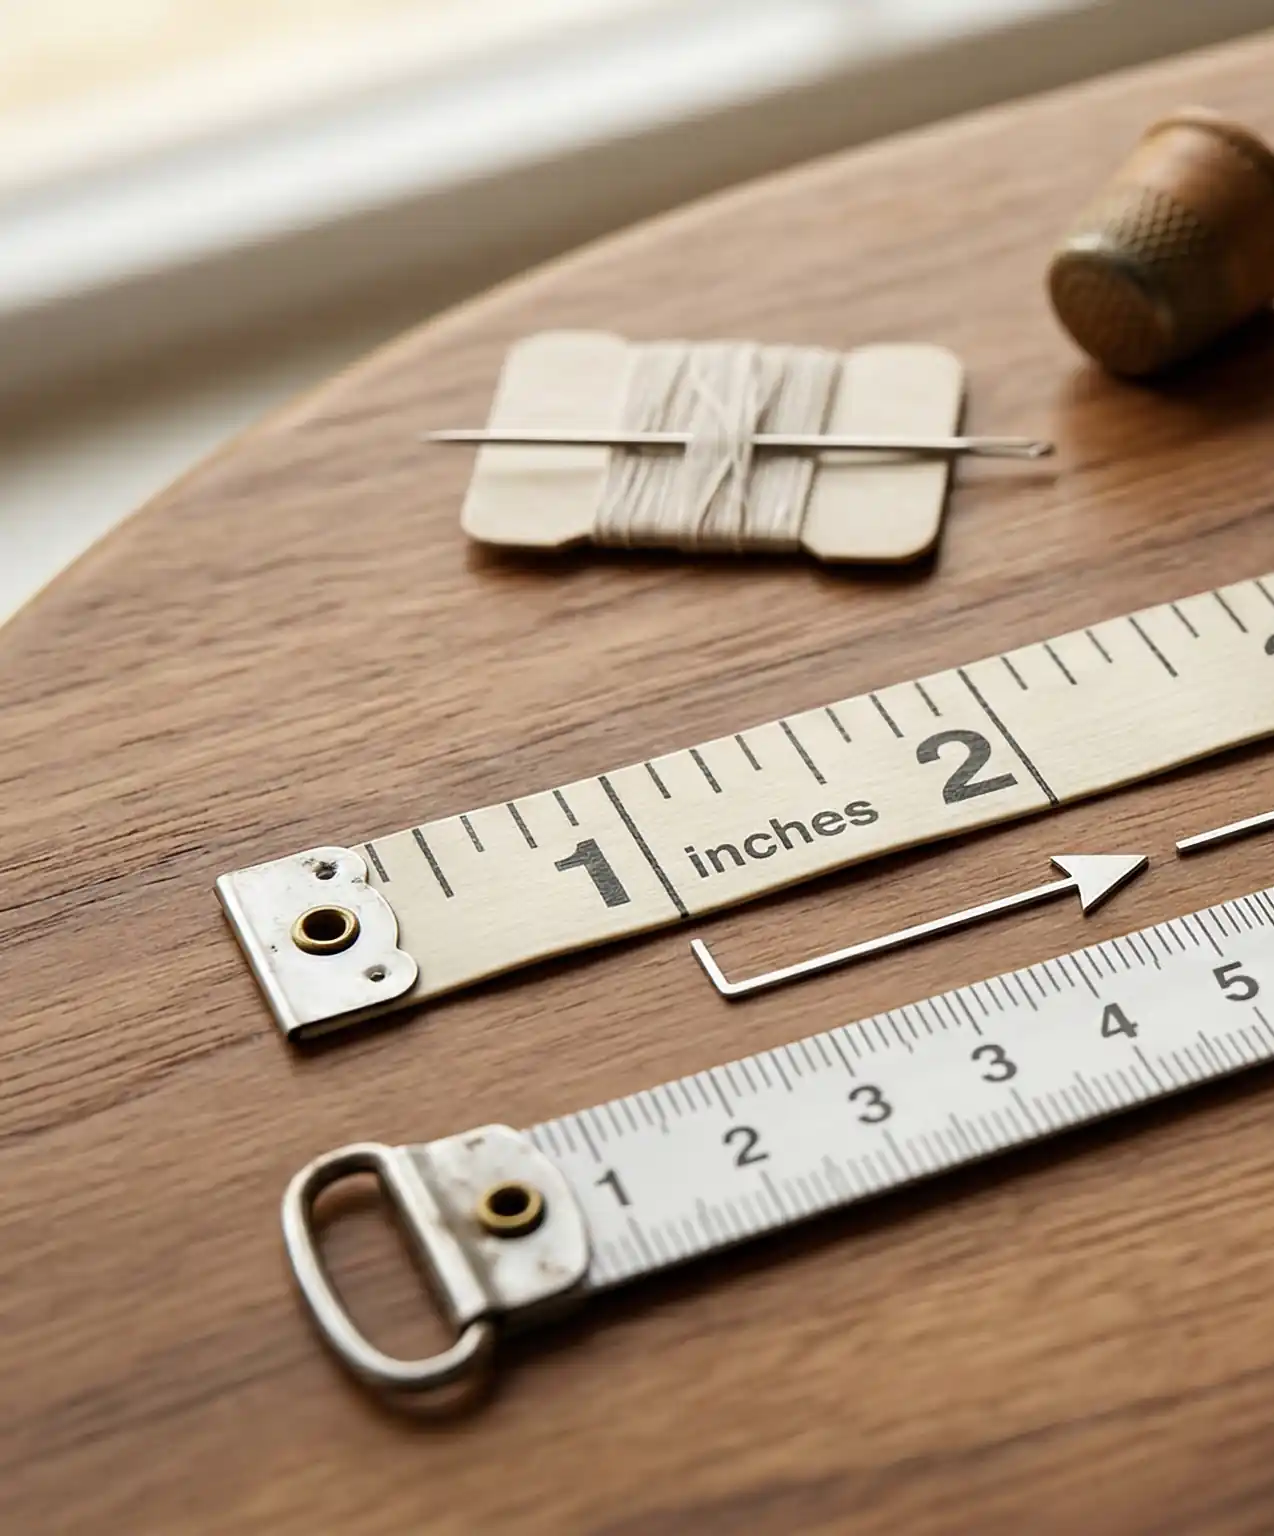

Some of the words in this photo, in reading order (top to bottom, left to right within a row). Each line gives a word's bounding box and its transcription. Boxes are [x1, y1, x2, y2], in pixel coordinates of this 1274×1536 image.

[554, 837, 632, 908] 1
[684, 799, 880, 879] inches
[915, 729, 1019, 805] 2
[597, 1169, 632, 1206] 1
[722, 1126, 769, 1167] 2
[847, 1084, 893, 1124] 3
[971, 1043, 1018, 1083] 3
[1100, 1002, 1139, 1041] 4
[1212, 961, 1260, 1002] 5
